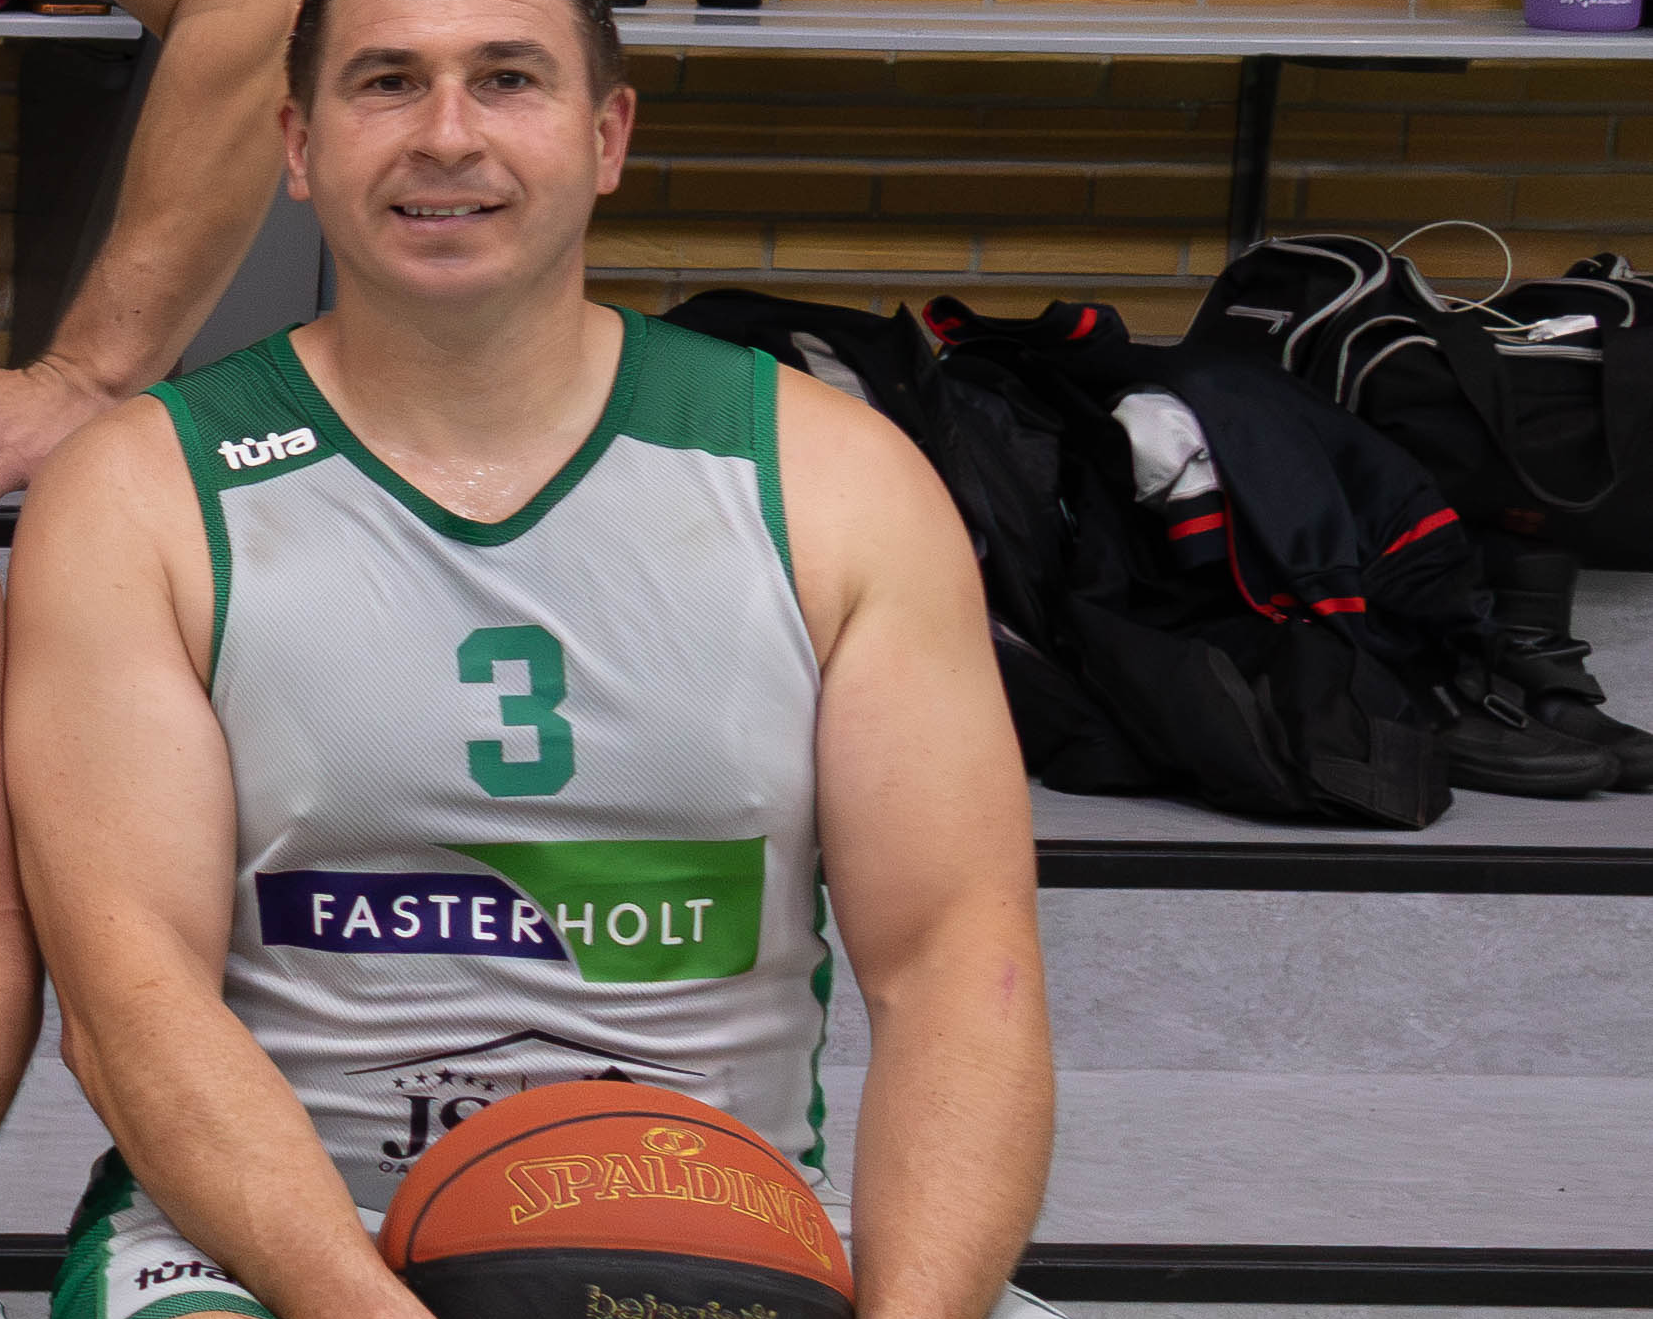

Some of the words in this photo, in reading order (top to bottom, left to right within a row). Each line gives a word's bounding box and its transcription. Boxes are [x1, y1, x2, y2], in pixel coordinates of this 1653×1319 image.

[456, 624, 575, 798] 3
[310, 892, 716, 946] FASTERHOLT
[504, 1153, 832, 1271] SPALDING
